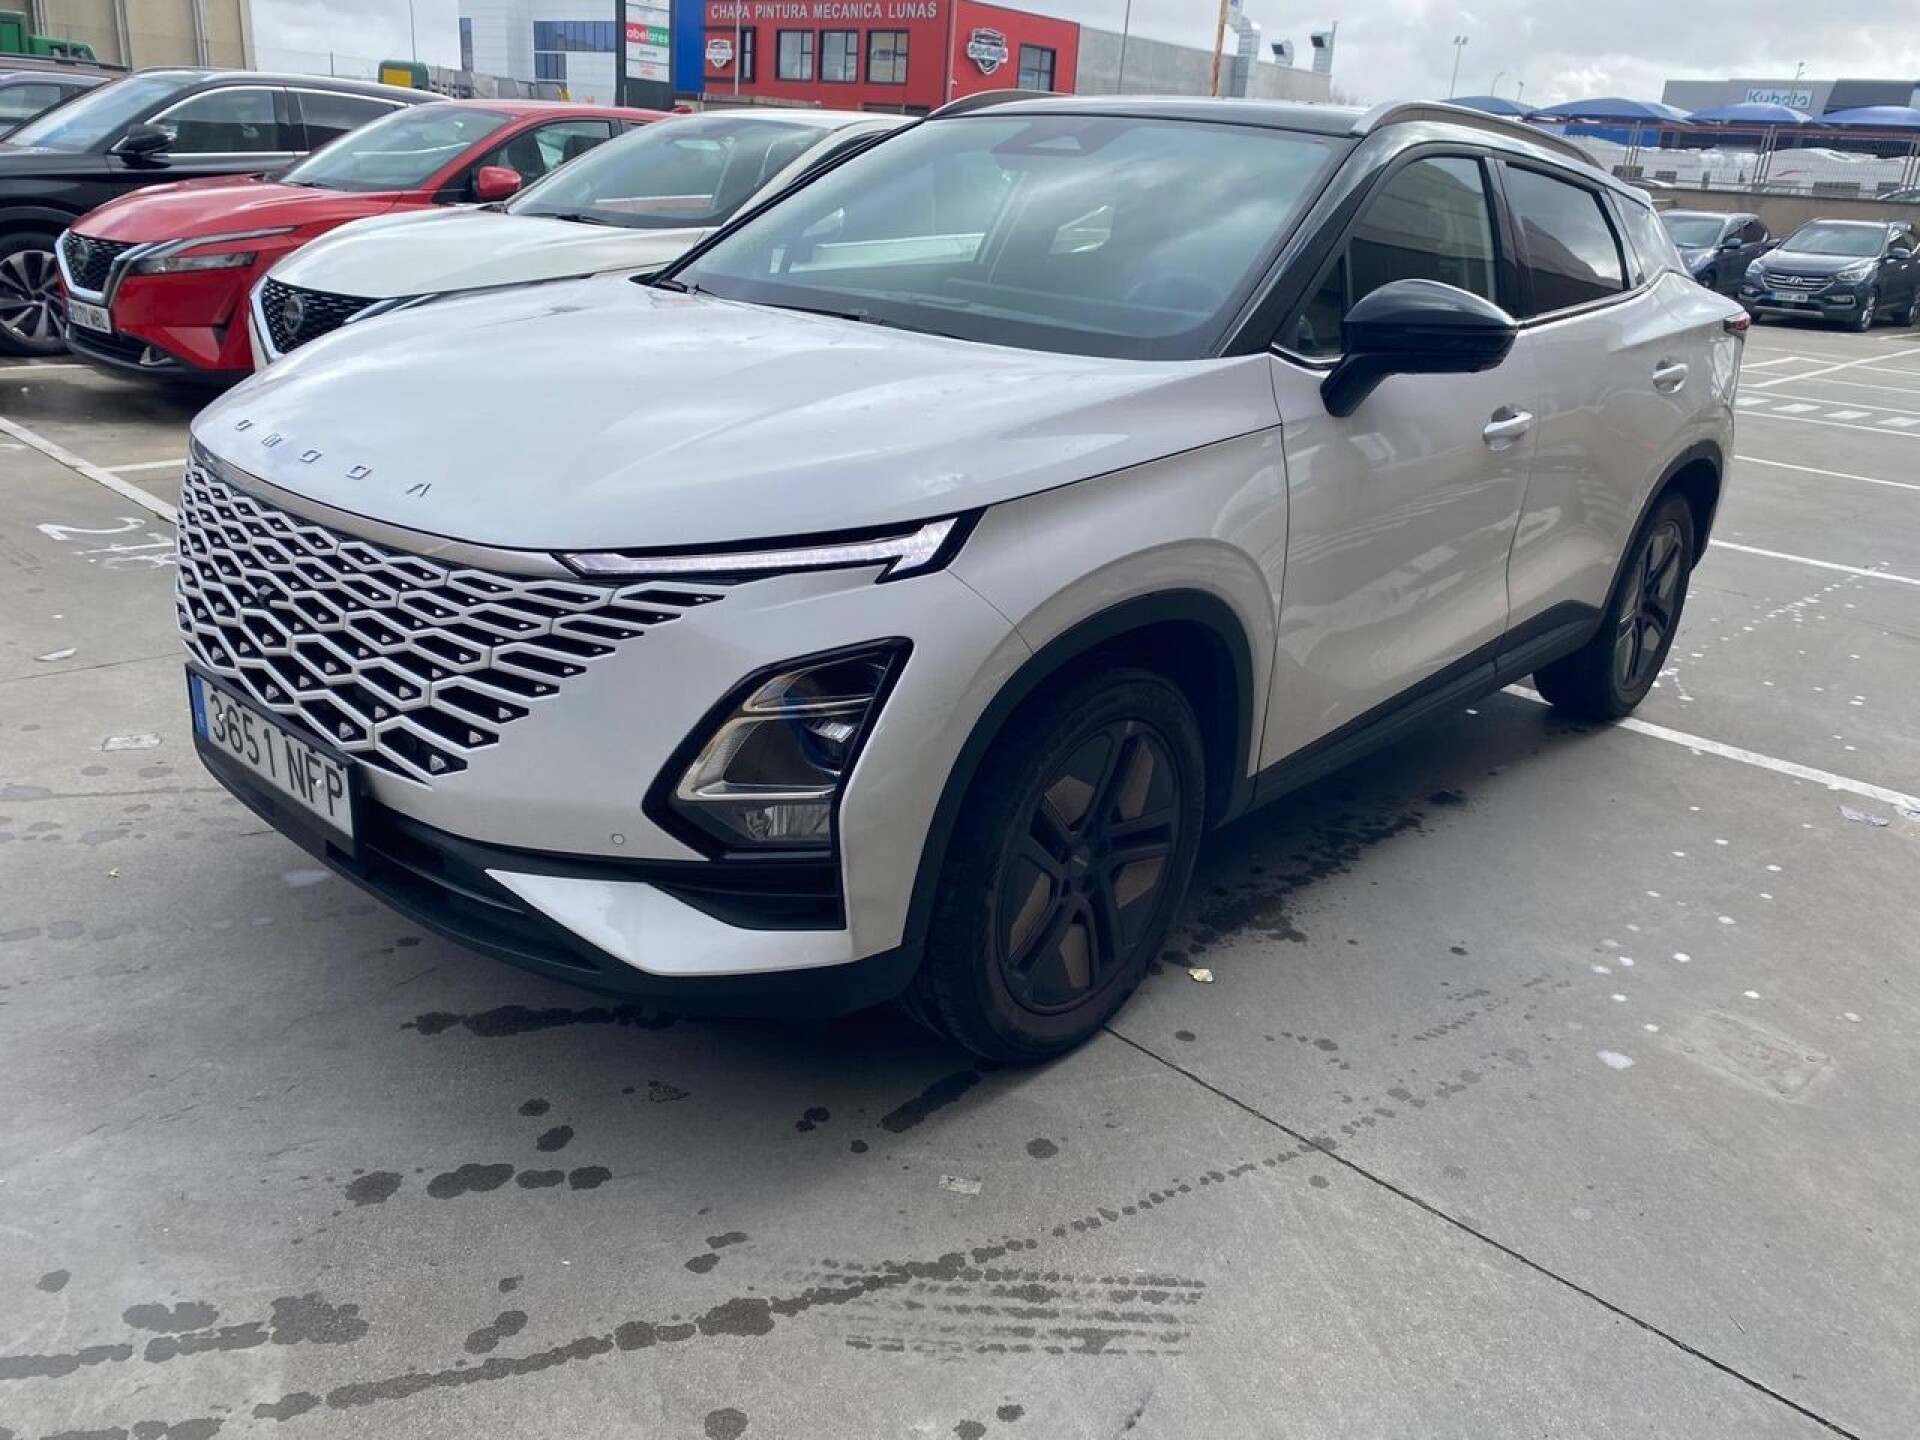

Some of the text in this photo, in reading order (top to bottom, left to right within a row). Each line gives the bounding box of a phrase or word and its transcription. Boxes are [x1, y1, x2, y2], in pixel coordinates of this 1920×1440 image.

[711, 2, 937, 19] CHAPA PINTURA MECANICA LUNAS
[210, 694, 342, 817] 3651 NFP
